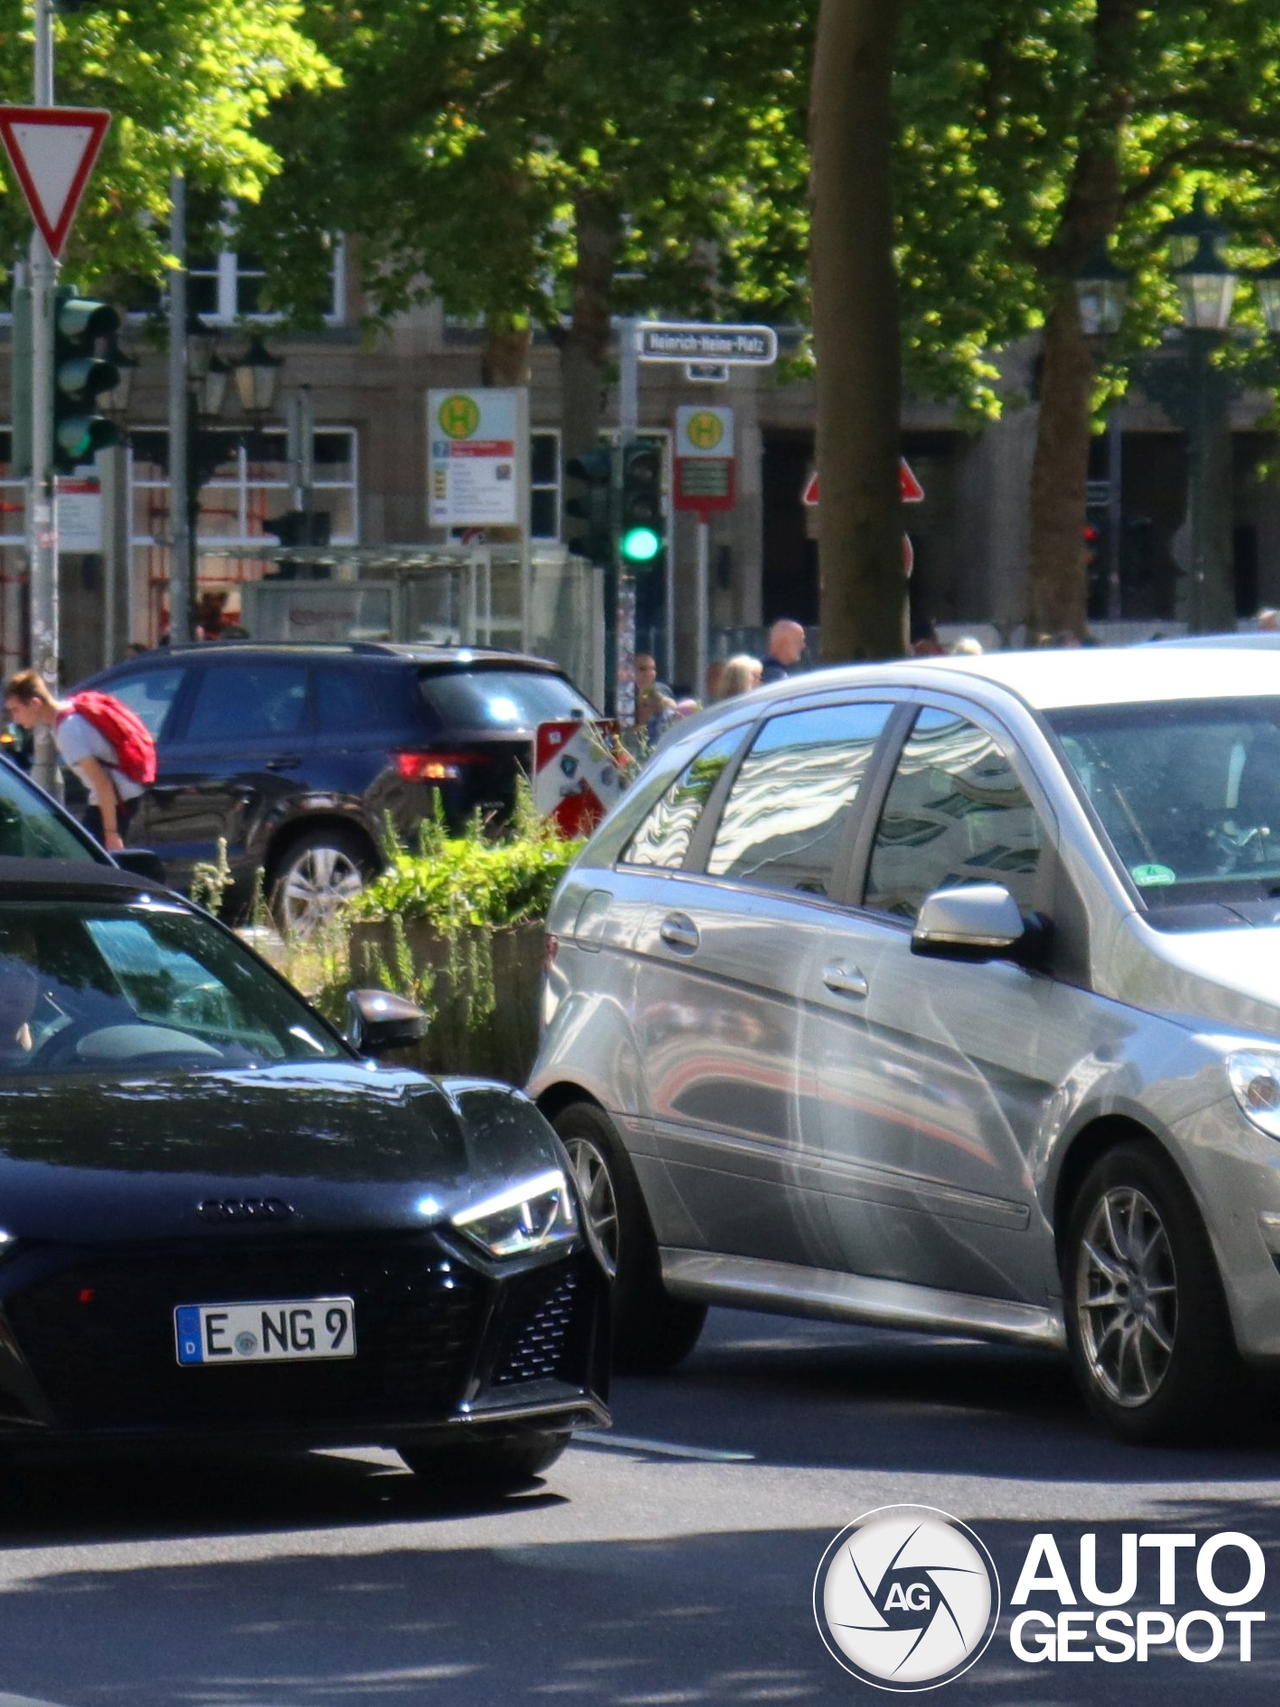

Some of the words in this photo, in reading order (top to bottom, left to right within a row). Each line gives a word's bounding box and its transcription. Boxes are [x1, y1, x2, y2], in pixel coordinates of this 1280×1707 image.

[205, 1313, 233, 1356] E
[261, 1308, 316, 1354] NG
[325, 1307, 348, 1350] 9
[185, 1341, 196, 1355] D
